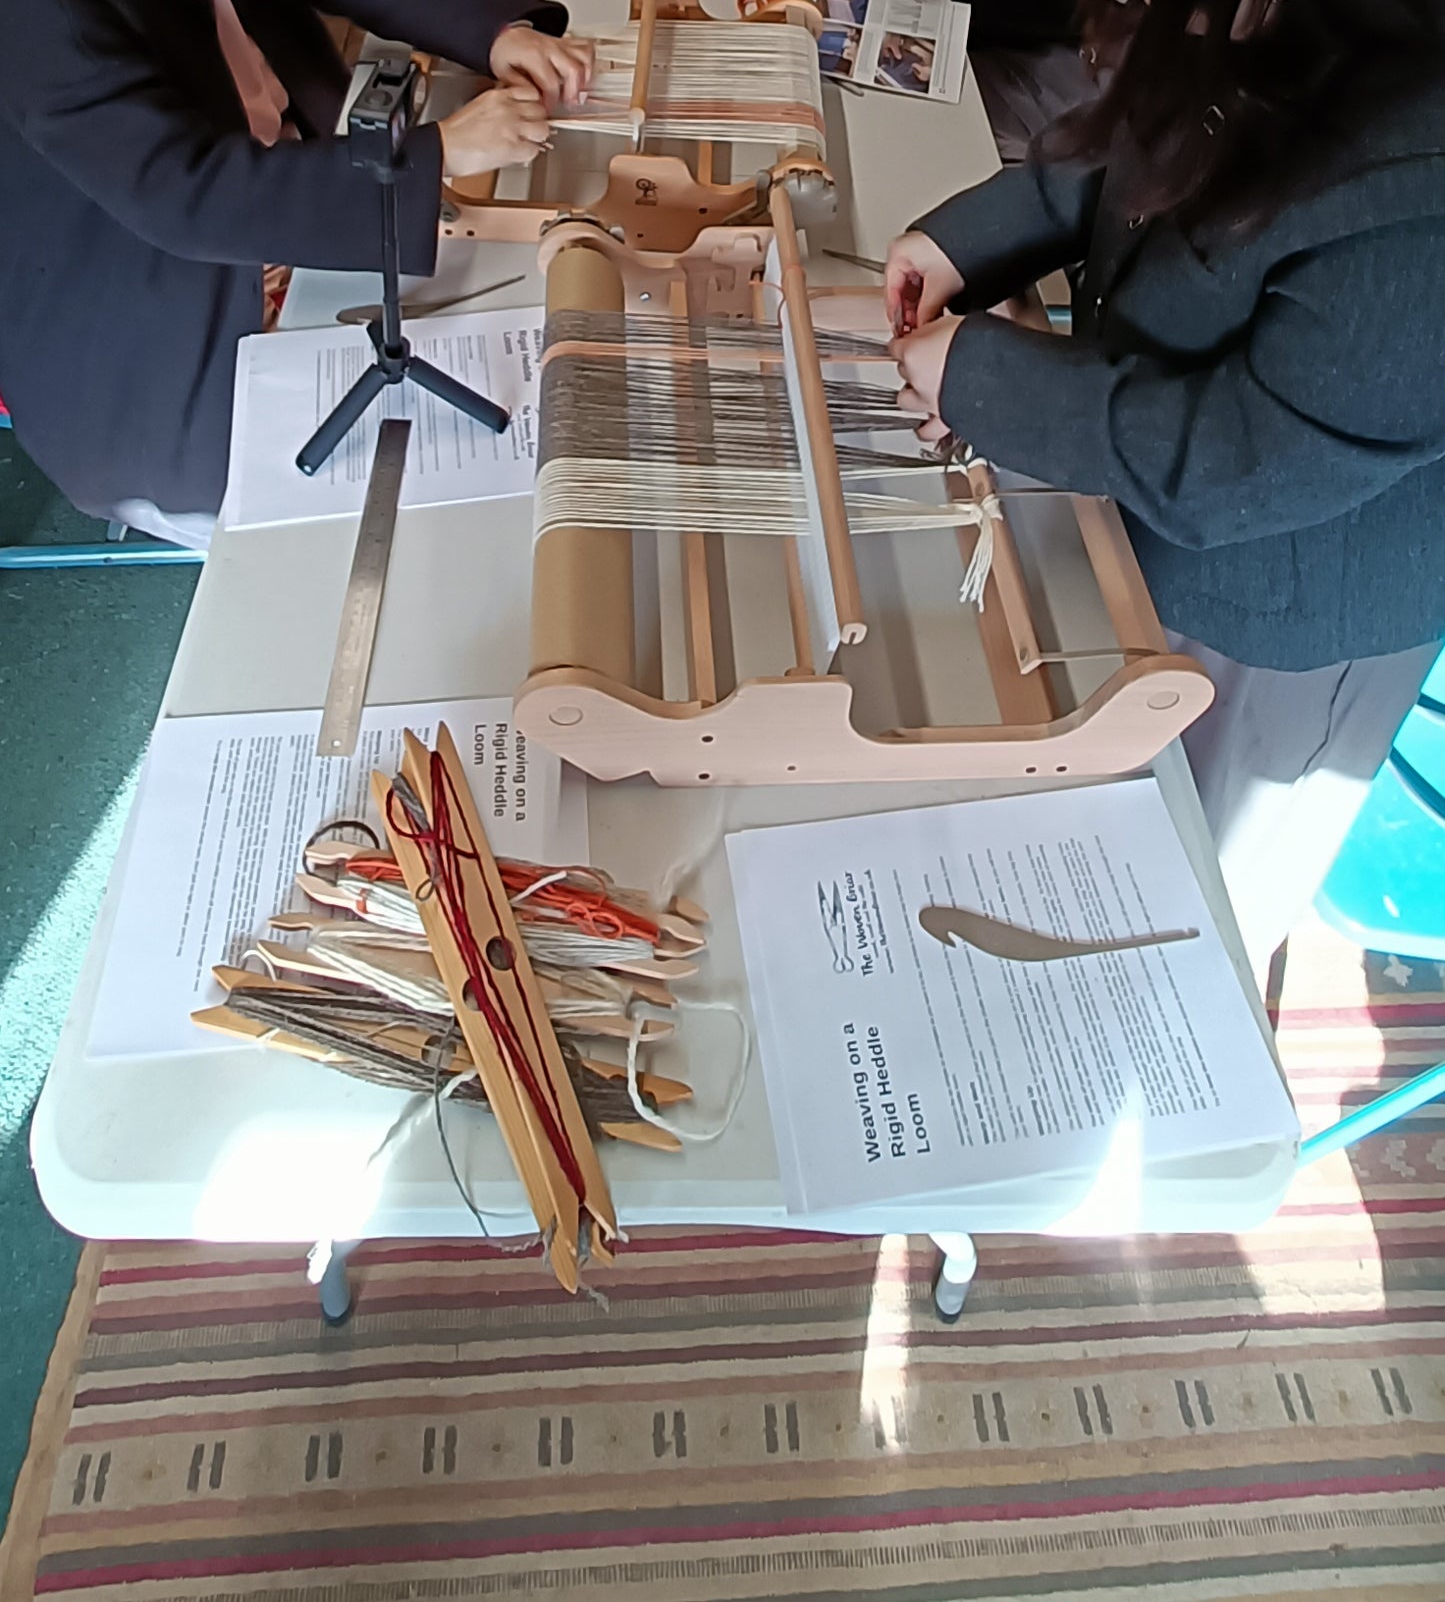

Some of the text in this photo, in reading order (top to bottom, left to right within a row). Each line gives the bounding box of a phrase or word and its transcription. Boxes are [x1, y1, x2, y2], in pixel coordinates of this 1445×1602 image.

[474, 724, 487, 765] Loom
[492, 723, 509, 817] Rigid Heddle
[512, 730, 529, 822] eaving on a
[844, 871, 858, 902] Briar
[853, 904, 868, 950] Woven
[860, 953, 874, 977] The
[844, 1022, 881, 1163] Weaving on a
[867, 1026, 906, 1157] Rigid Heddle
[907, 1093, 931, 1154] Loom
